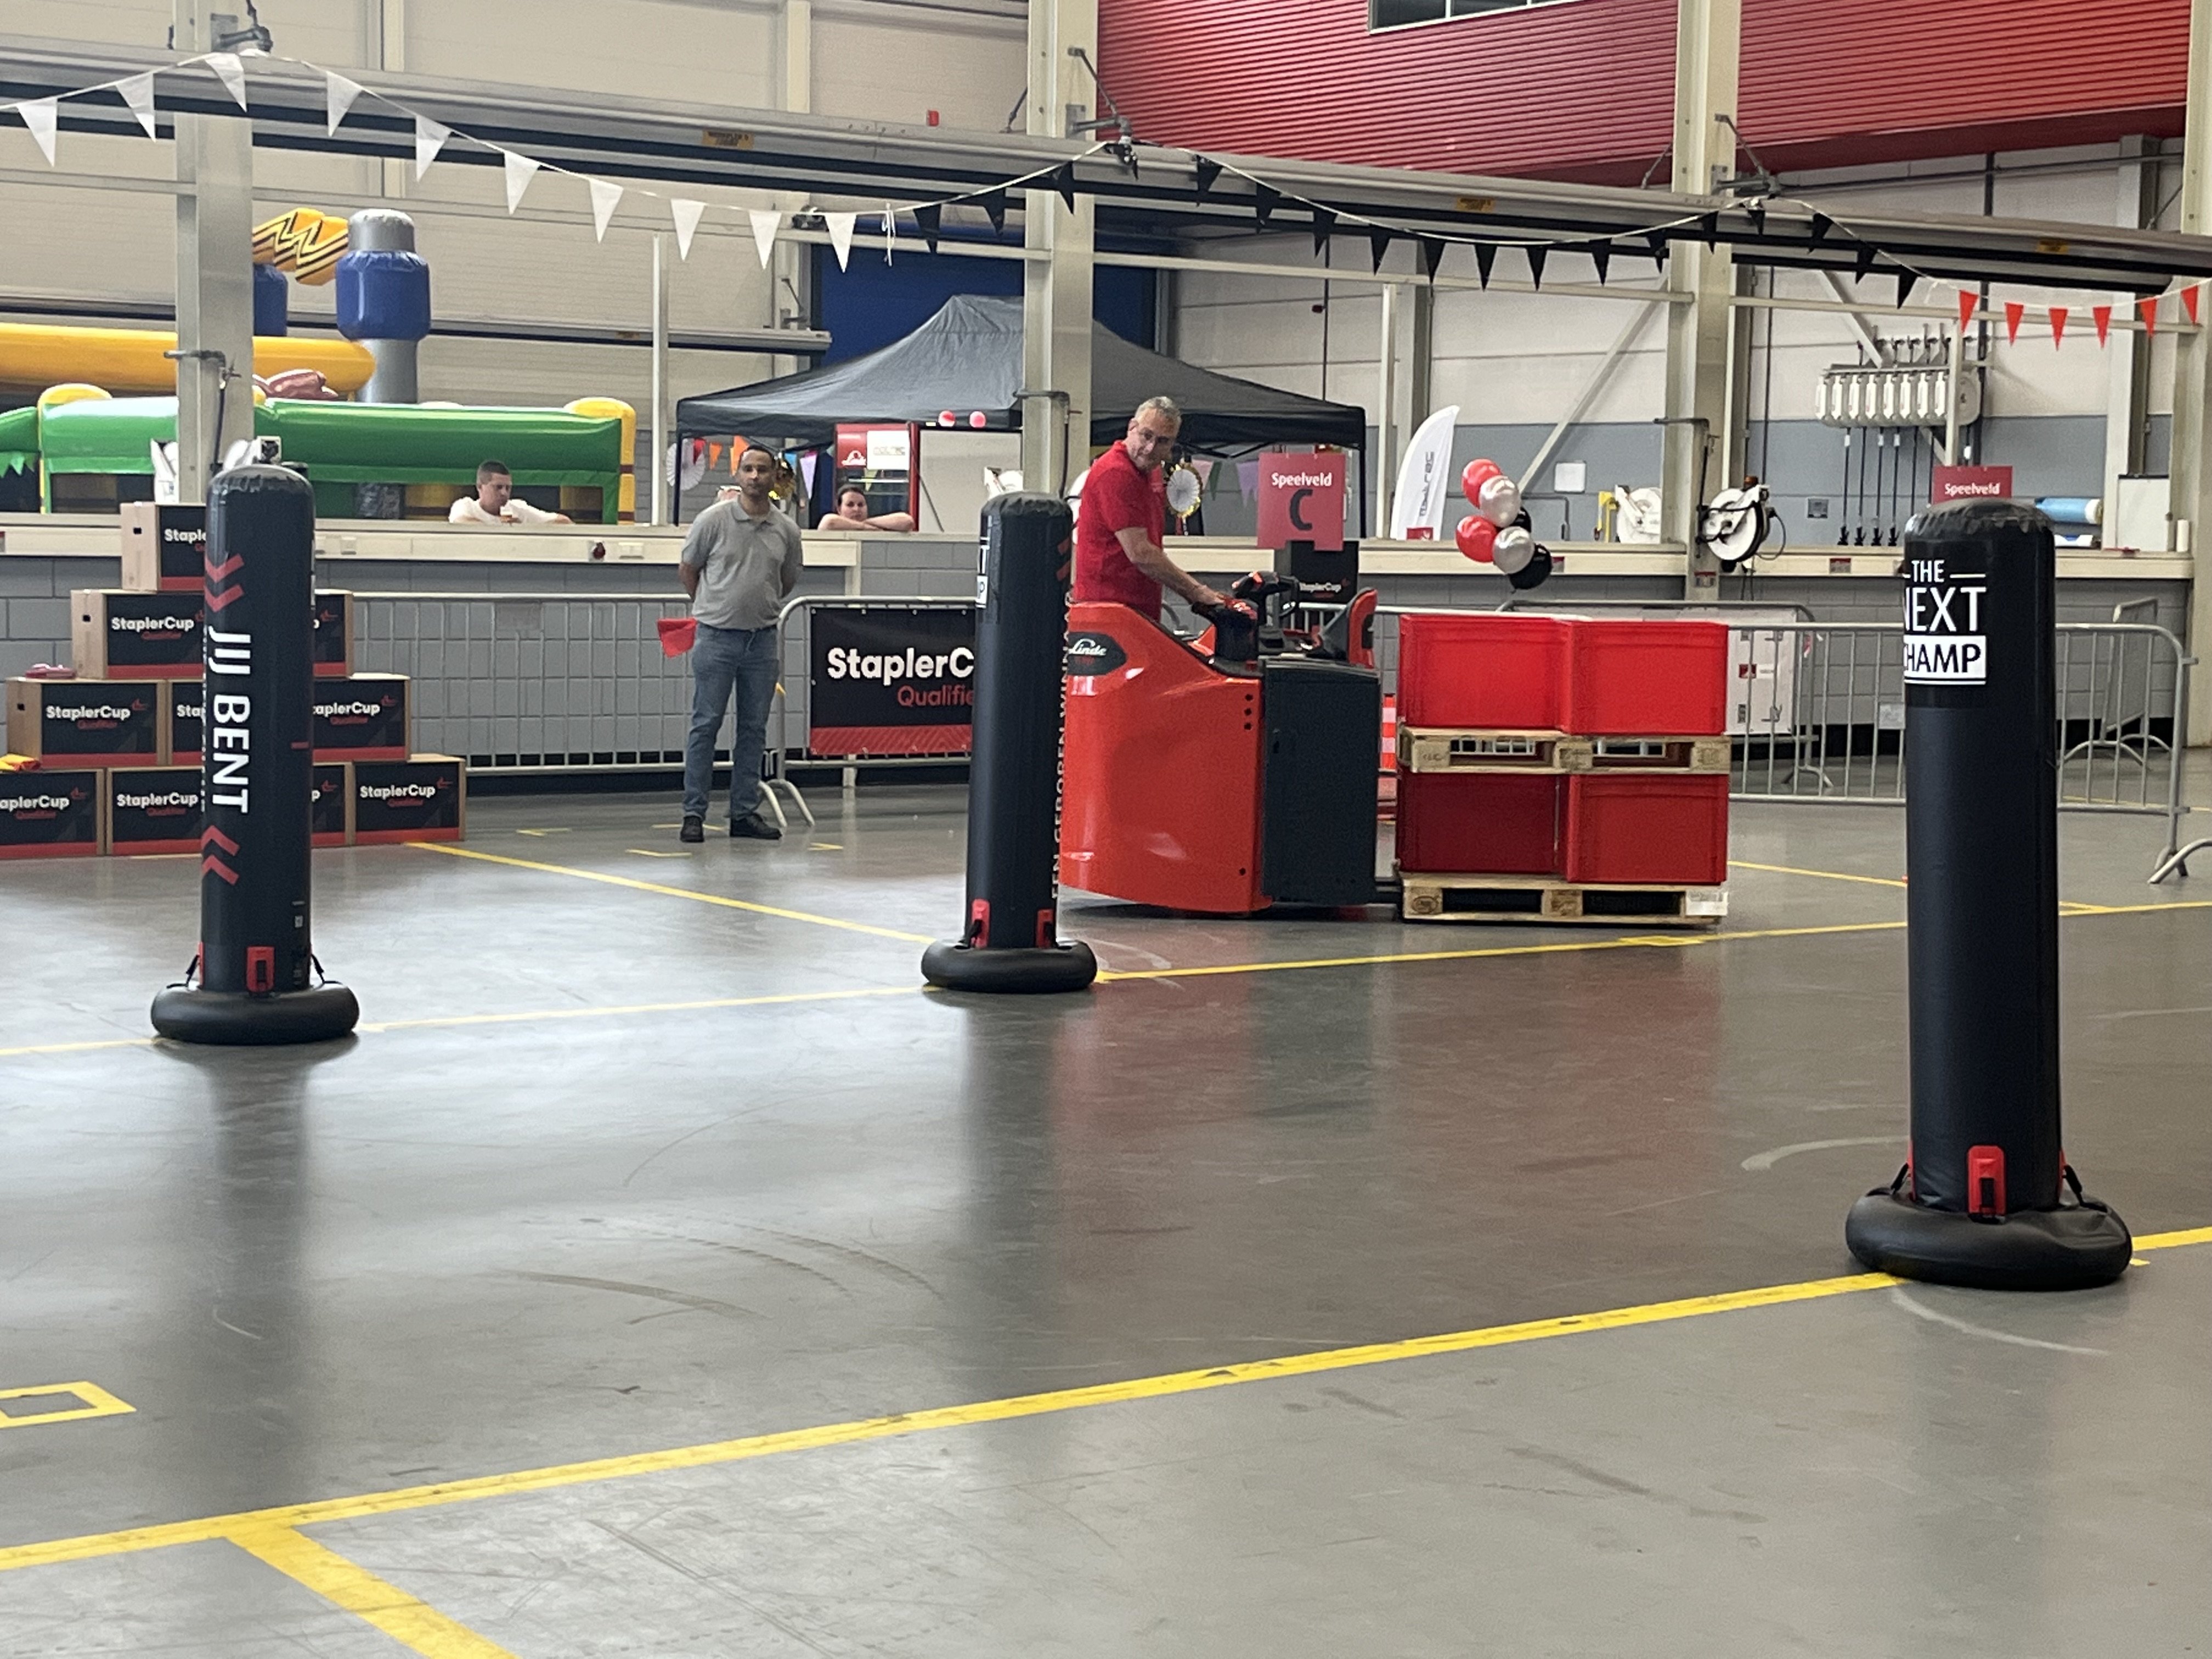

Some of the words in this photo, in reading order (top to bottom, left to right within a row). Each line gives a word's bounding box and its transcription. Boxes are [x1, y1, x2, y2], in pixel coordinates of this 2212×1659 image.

[1271, 472, 1332, 489] Speelveld
[1944, 482, 2001, 497] Speelveld
[1290, 488, 1313, 531] C
[1911, 559, 1945, 583] THE
[111, 616, 194, 633] StaplerCup
[208, 625, 251, 675] JIJ
[1068, 638, 1107, 656] Linde
[827, 647, 974, 686] StaplerC
[1905, 644, 1981, 674] HAMP
[46, 705, 131, 721] StaplerCup
[212, 694, 251, 814] BENT
[116, 792, 199, 809] StaplerCup
[359, 783, 436, 800] StaplerCup
